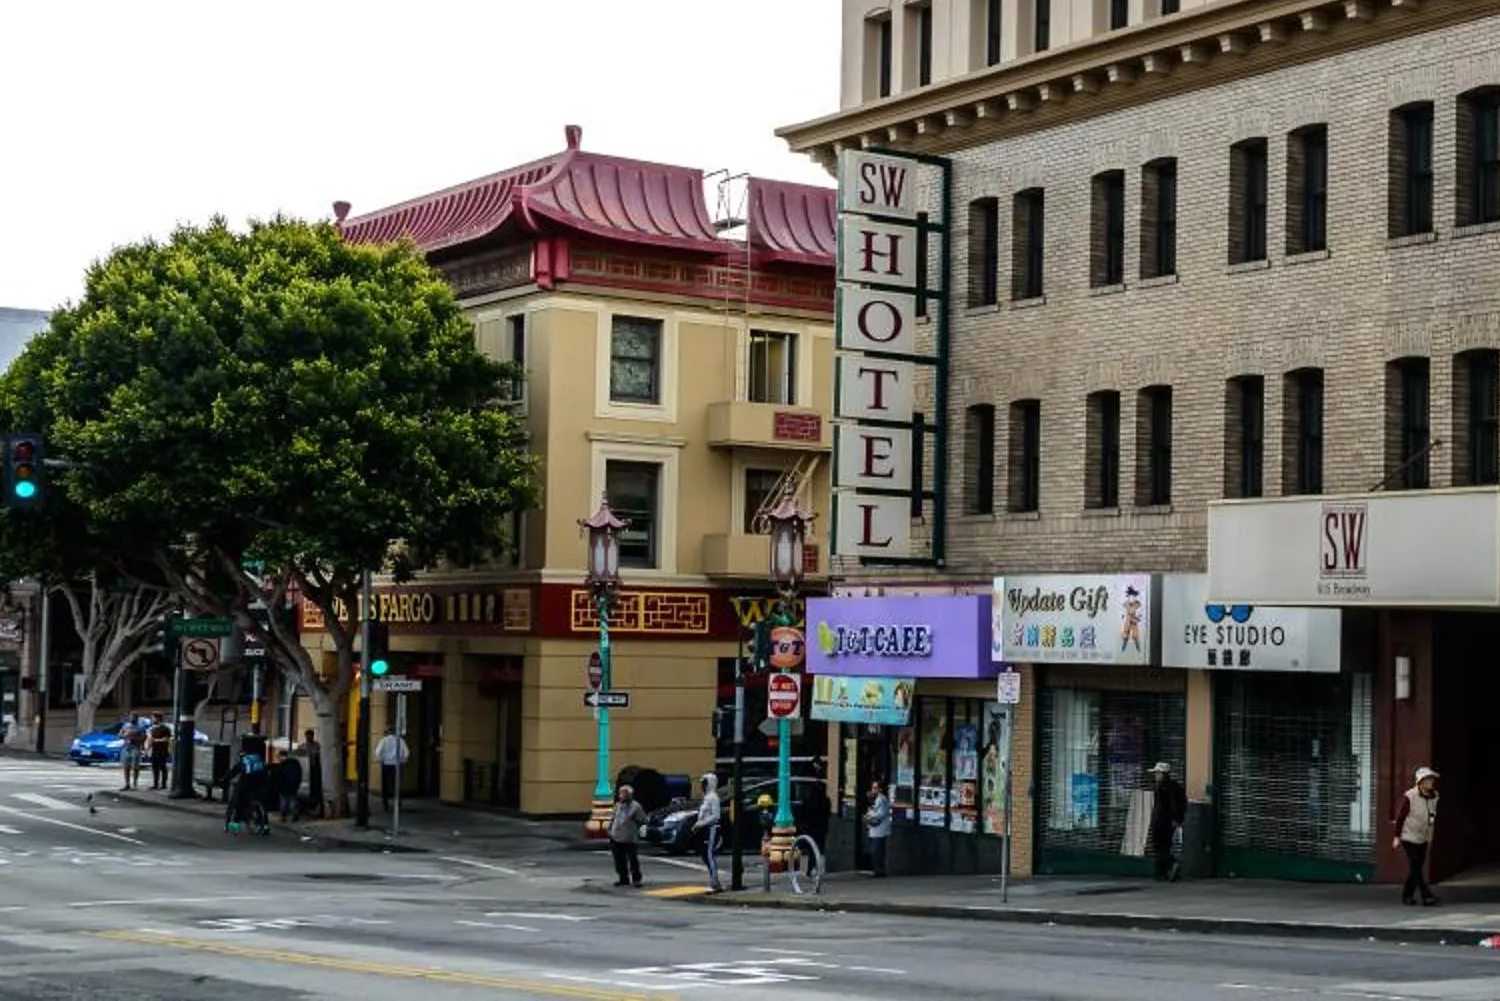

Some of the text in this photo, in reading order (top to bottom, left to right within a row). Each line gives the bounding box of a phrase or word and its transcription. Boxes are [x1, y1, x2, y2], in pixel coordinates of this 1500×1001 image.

[860, 162, 907, 207] SW
[858, 229, 903, 548] HOTEL
[1324, 512, 1365, 570] SW
[379, 594, 434, 623] FARGO
[1007, 584, 1109, 618] Update Gift
[874, 626, 929, 652] CAFE
[1184, 624, 1286, 647] EYE STUDIO
